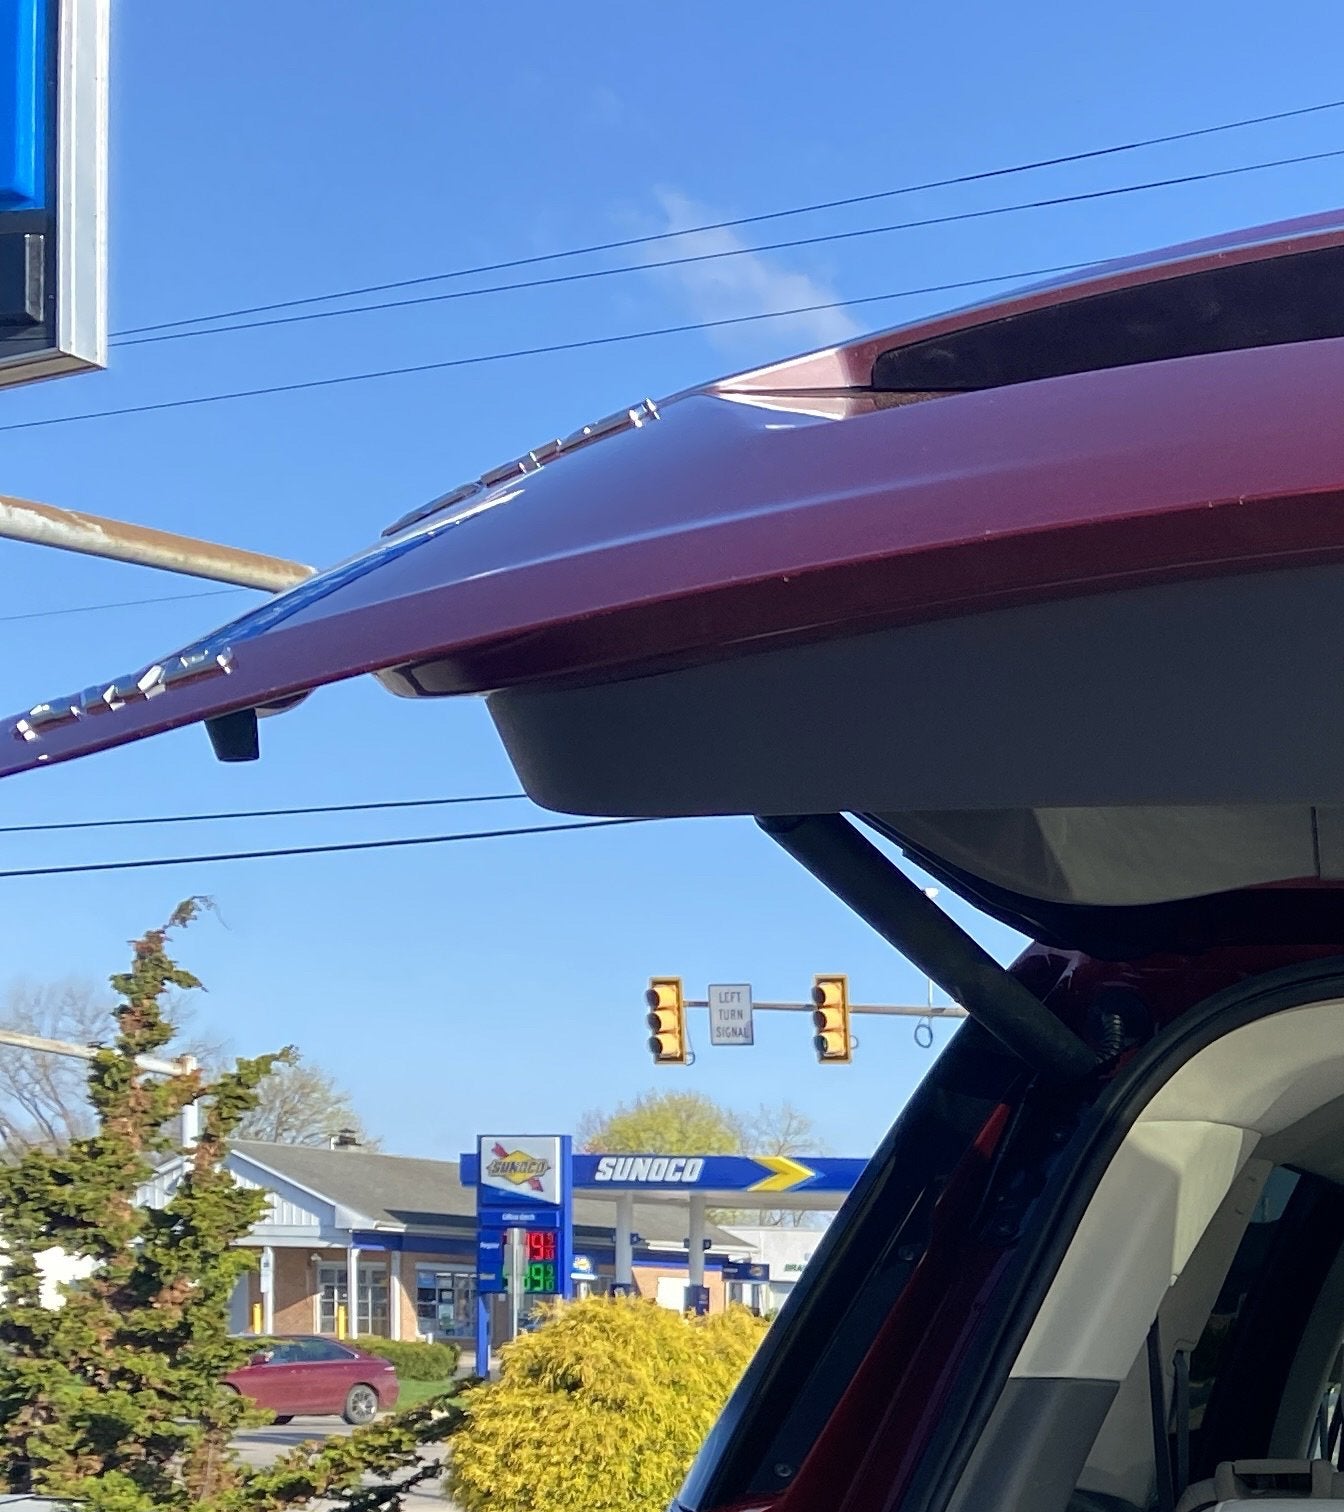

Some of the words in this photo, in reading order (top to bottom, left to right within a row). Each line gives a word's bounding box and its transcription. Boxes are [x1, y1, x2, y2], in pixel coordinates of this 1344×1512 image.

[718, 991, 741, 1004] LEFT
[718, 1009, 744, 1021] TURN
[715, 1026, 751, 1039] SIGNAL
[490, 1159, 547, 1175] SUNOCO
[594, 1156, 705, 1183] SUNOCO
